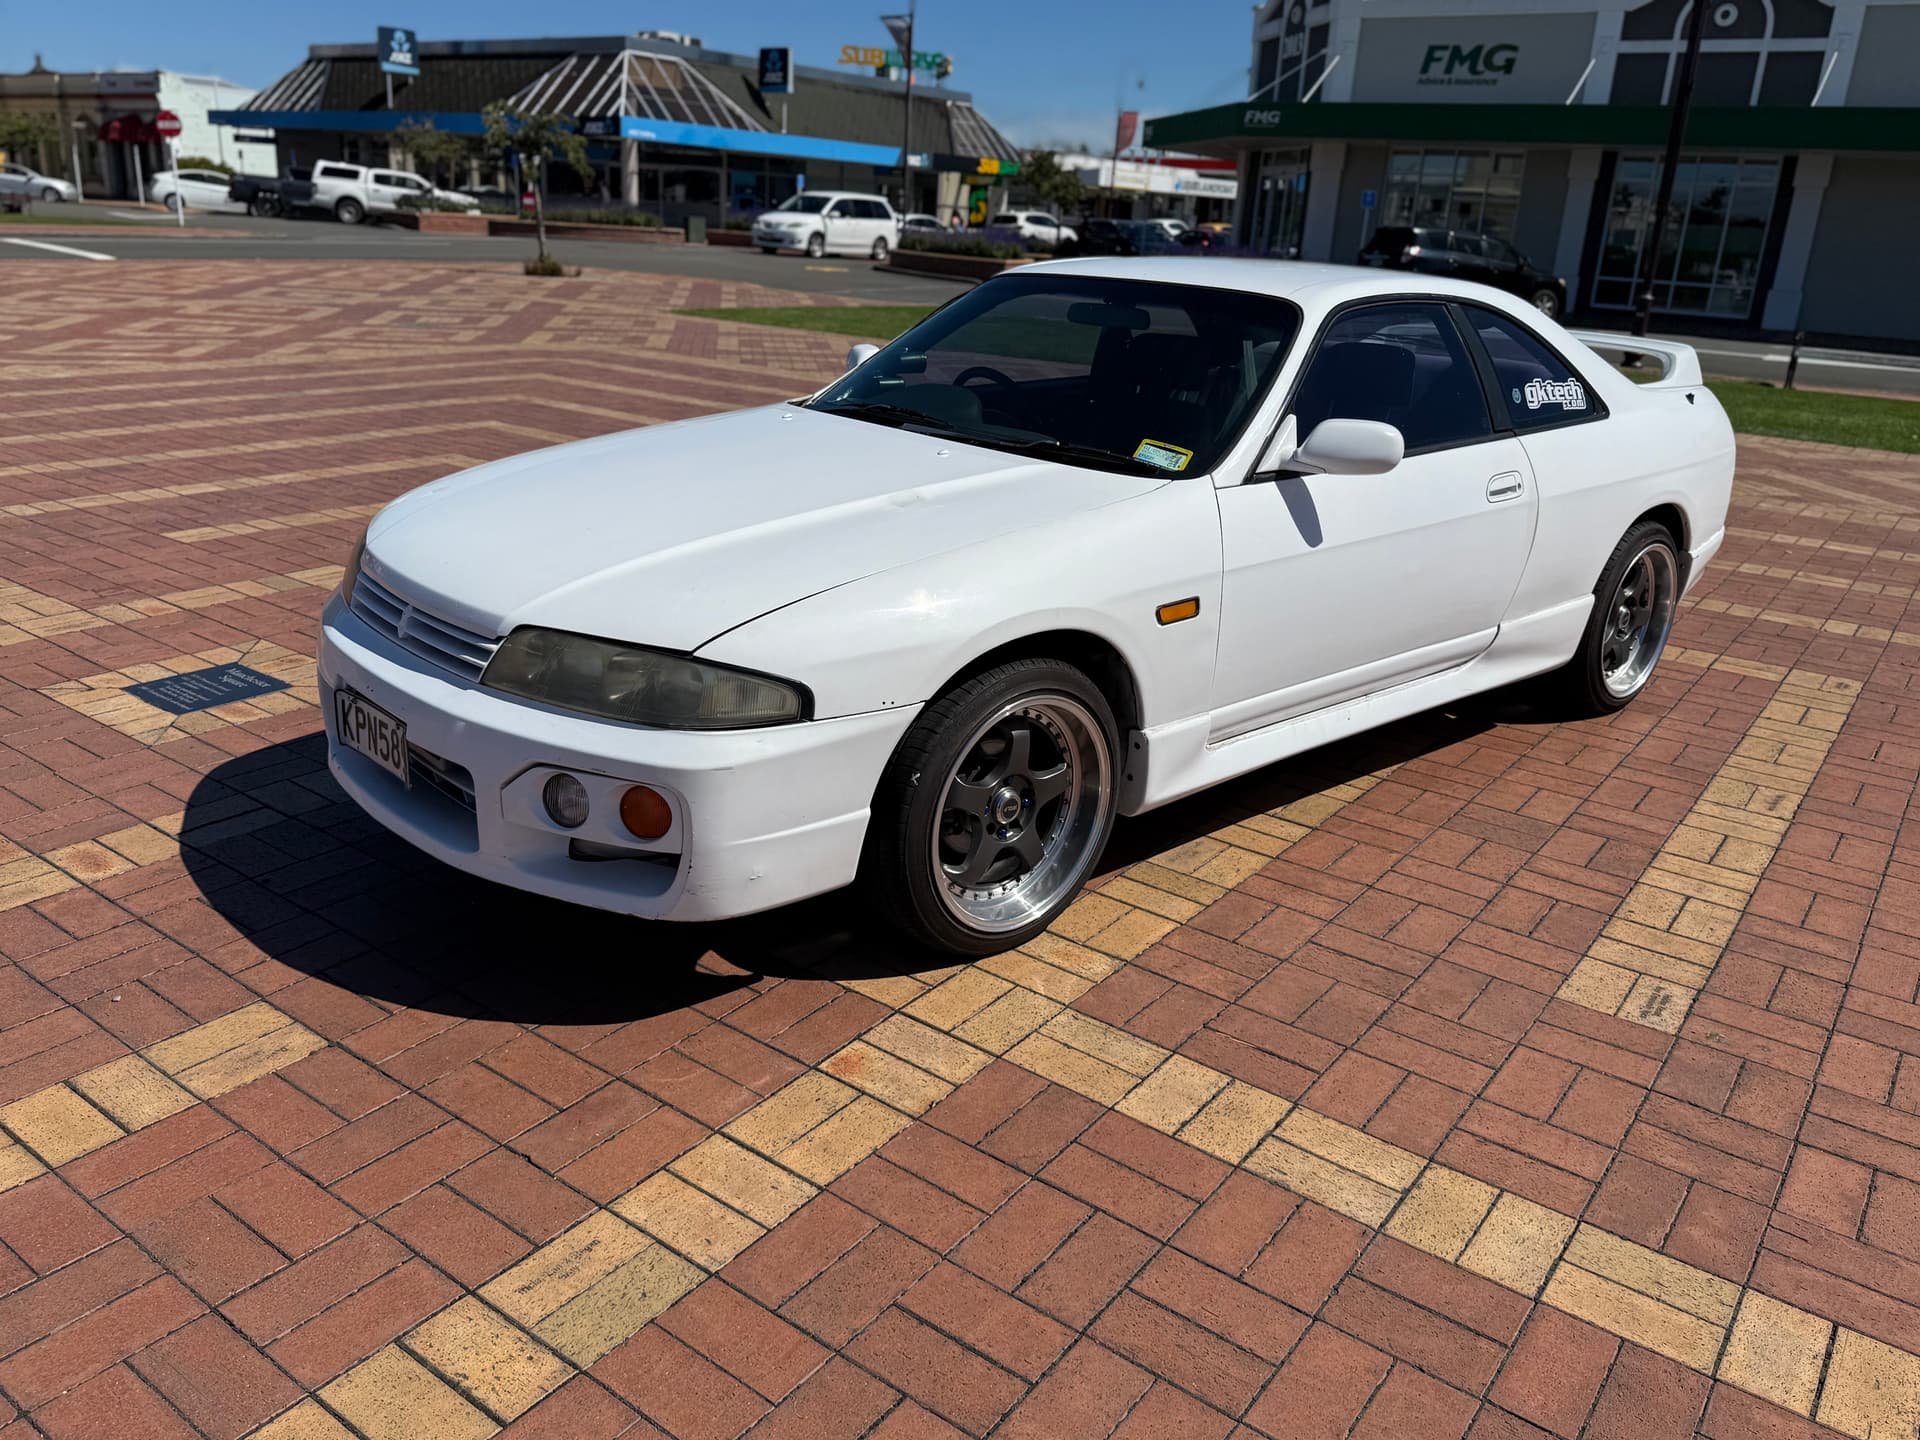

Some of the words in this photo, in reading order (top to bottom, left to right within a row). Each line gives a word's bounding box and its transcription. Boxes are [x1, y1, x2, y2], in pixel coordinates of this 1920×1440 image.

[1420, 43, 1519, 75] FMG
[1244, 110, 1281, 124] FMG
[1525, 378, 1583, 409] gktech
